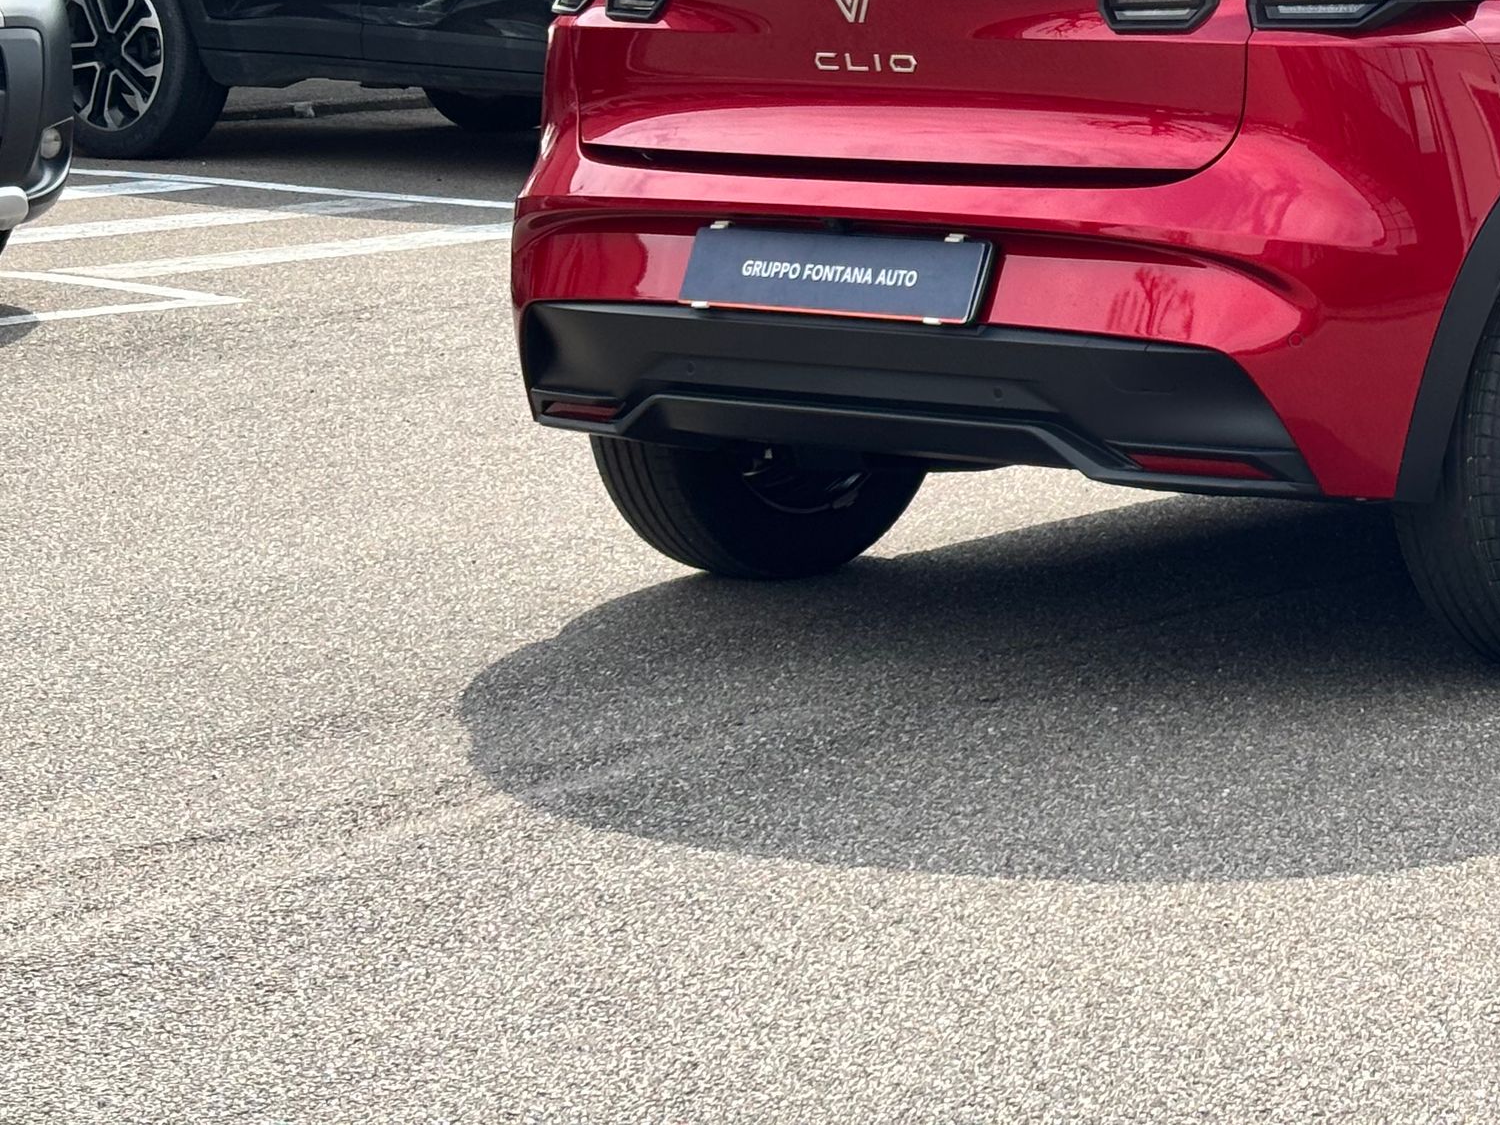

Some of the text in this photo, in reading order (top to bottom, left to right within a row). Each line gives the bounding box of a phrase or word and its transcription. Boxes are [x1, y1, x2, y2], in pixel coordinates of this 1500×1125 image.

[814, 52, 918, 73] CLIO
[742, 259, 918, 287] GRUPPO FONTANA AUTO
